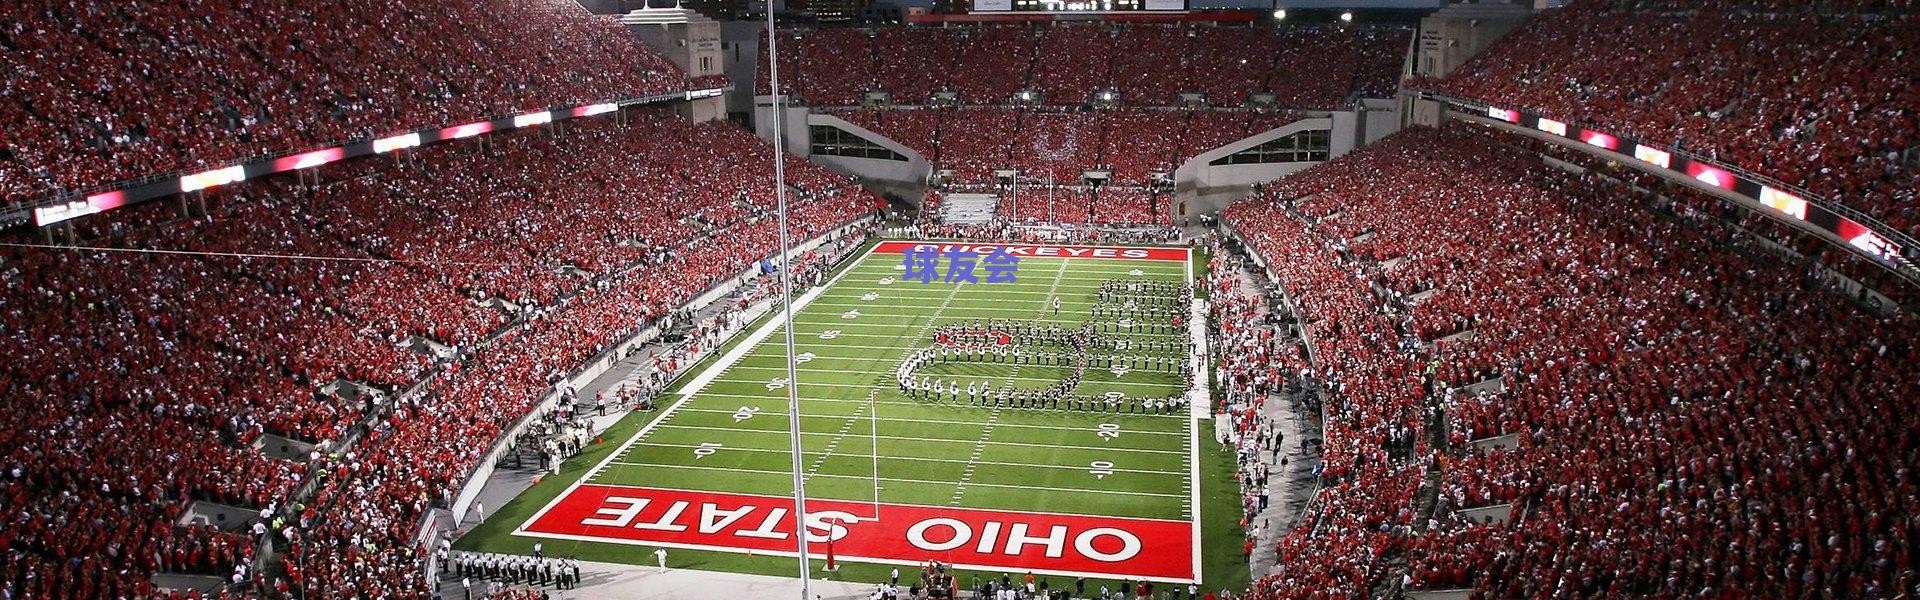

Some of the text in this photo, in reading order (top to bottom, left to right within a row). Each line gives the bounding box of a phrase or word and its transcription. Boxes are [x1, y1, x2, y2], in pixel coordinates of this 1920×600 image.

[914, 243, 1149, 258] BUCKEYES
[1097, 423, 1120, 437] 20
[694, 442, 723, 455] 10
[1089, 461, 1114, 474] 10
[580, 496, 1143, 562] OHIO STATE
